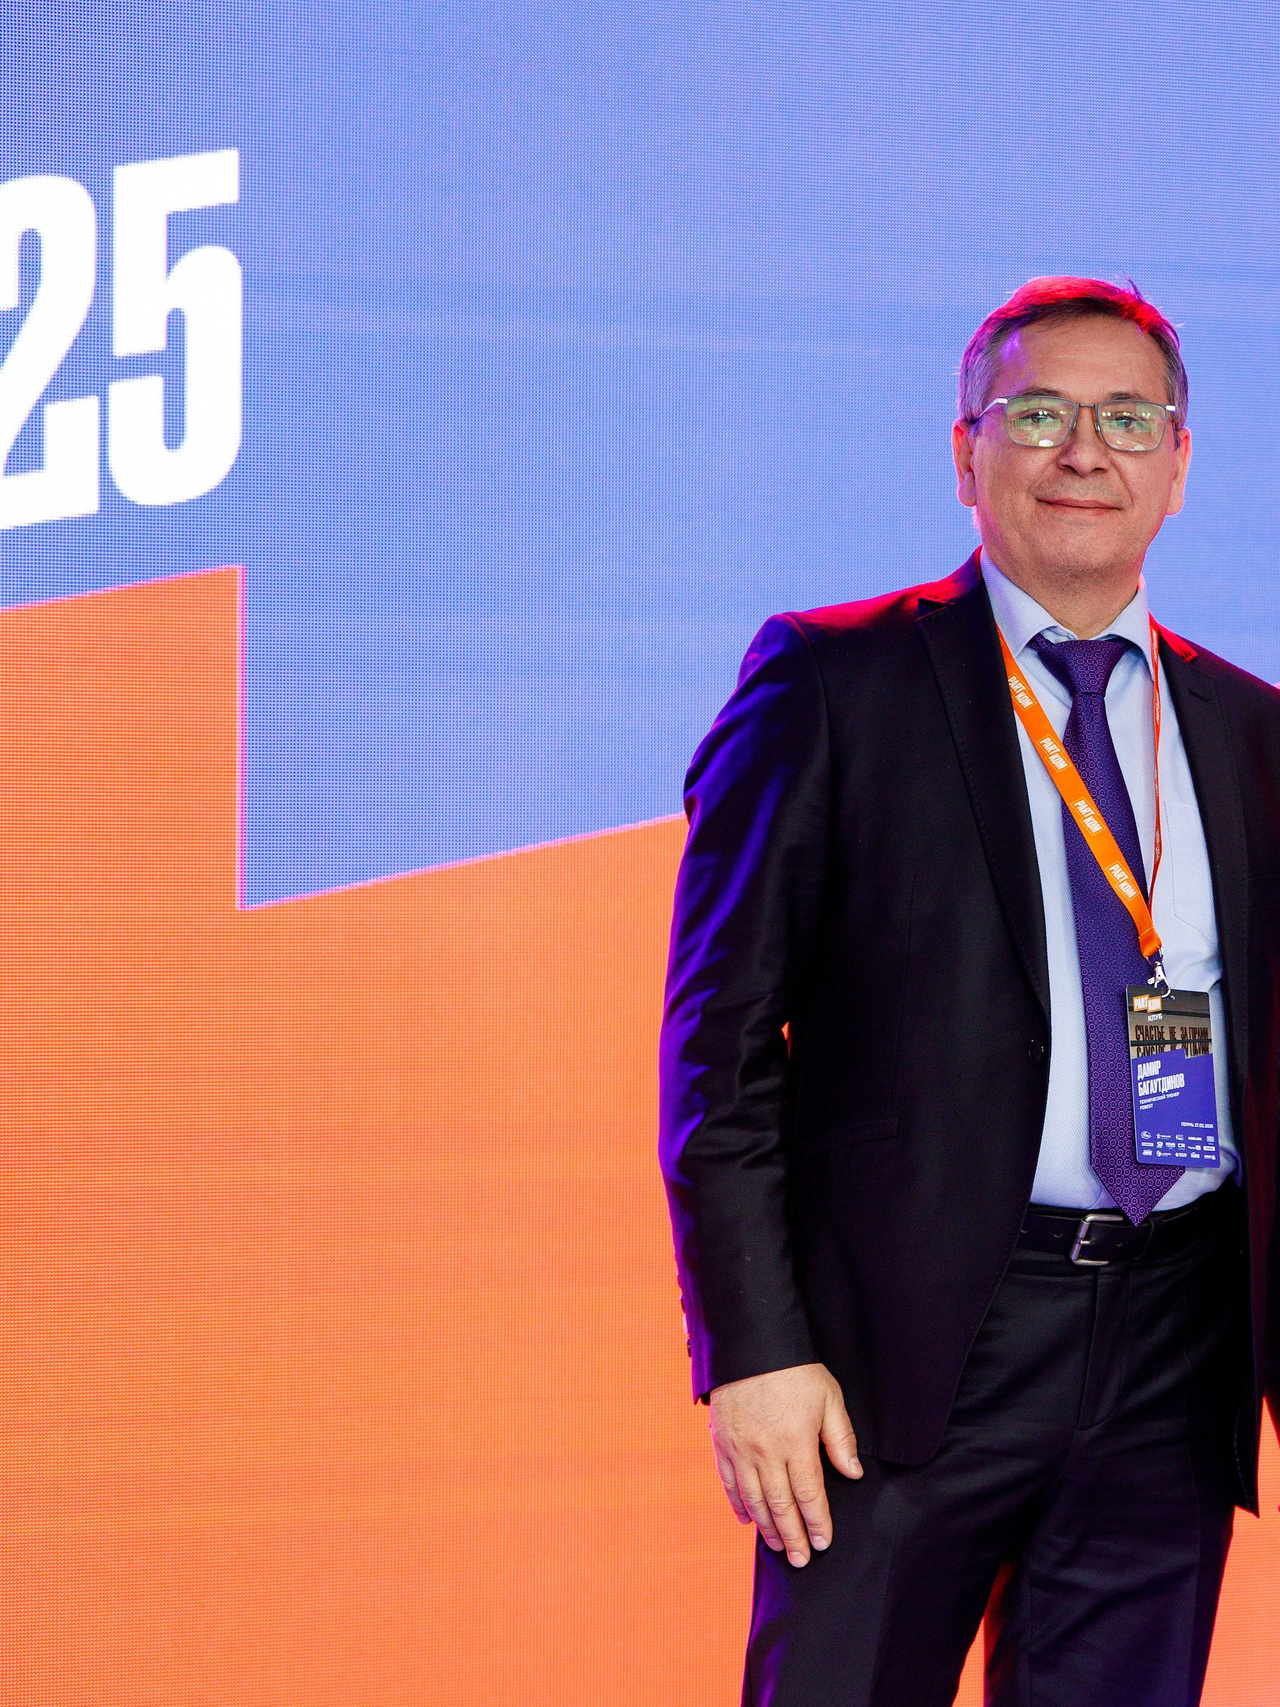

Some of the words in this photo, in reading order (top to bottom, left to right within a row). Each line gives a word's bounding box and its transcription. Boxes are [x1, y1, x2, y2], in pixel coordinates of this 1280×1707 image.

[0, 147, 243, 532] 25
[1008, 675, 1027, 694] PART
[1014, 692, 1034, 710] KOM
[1039, 736, 1062, 759] PART
[1048, 752, 1068, 771] KOM
[1073, 799, 1096, 820] PART
[1082, 814, 1104, 835] KOM
[1109, 863, 1131, 884] PART
[1118, 878, 1138, 900] KOM
[1134, 1024, 1166, 1041] СЧАСТЬЕ
[1168, 1026, 1177, 1040] НЕ
[1180, 1026, 1188, 1040] ЗА
[1137, 1060, 1162, 1081] ДАМИР
[1137, 1072, 1185, 1097] БАГАУТДИНОВ
